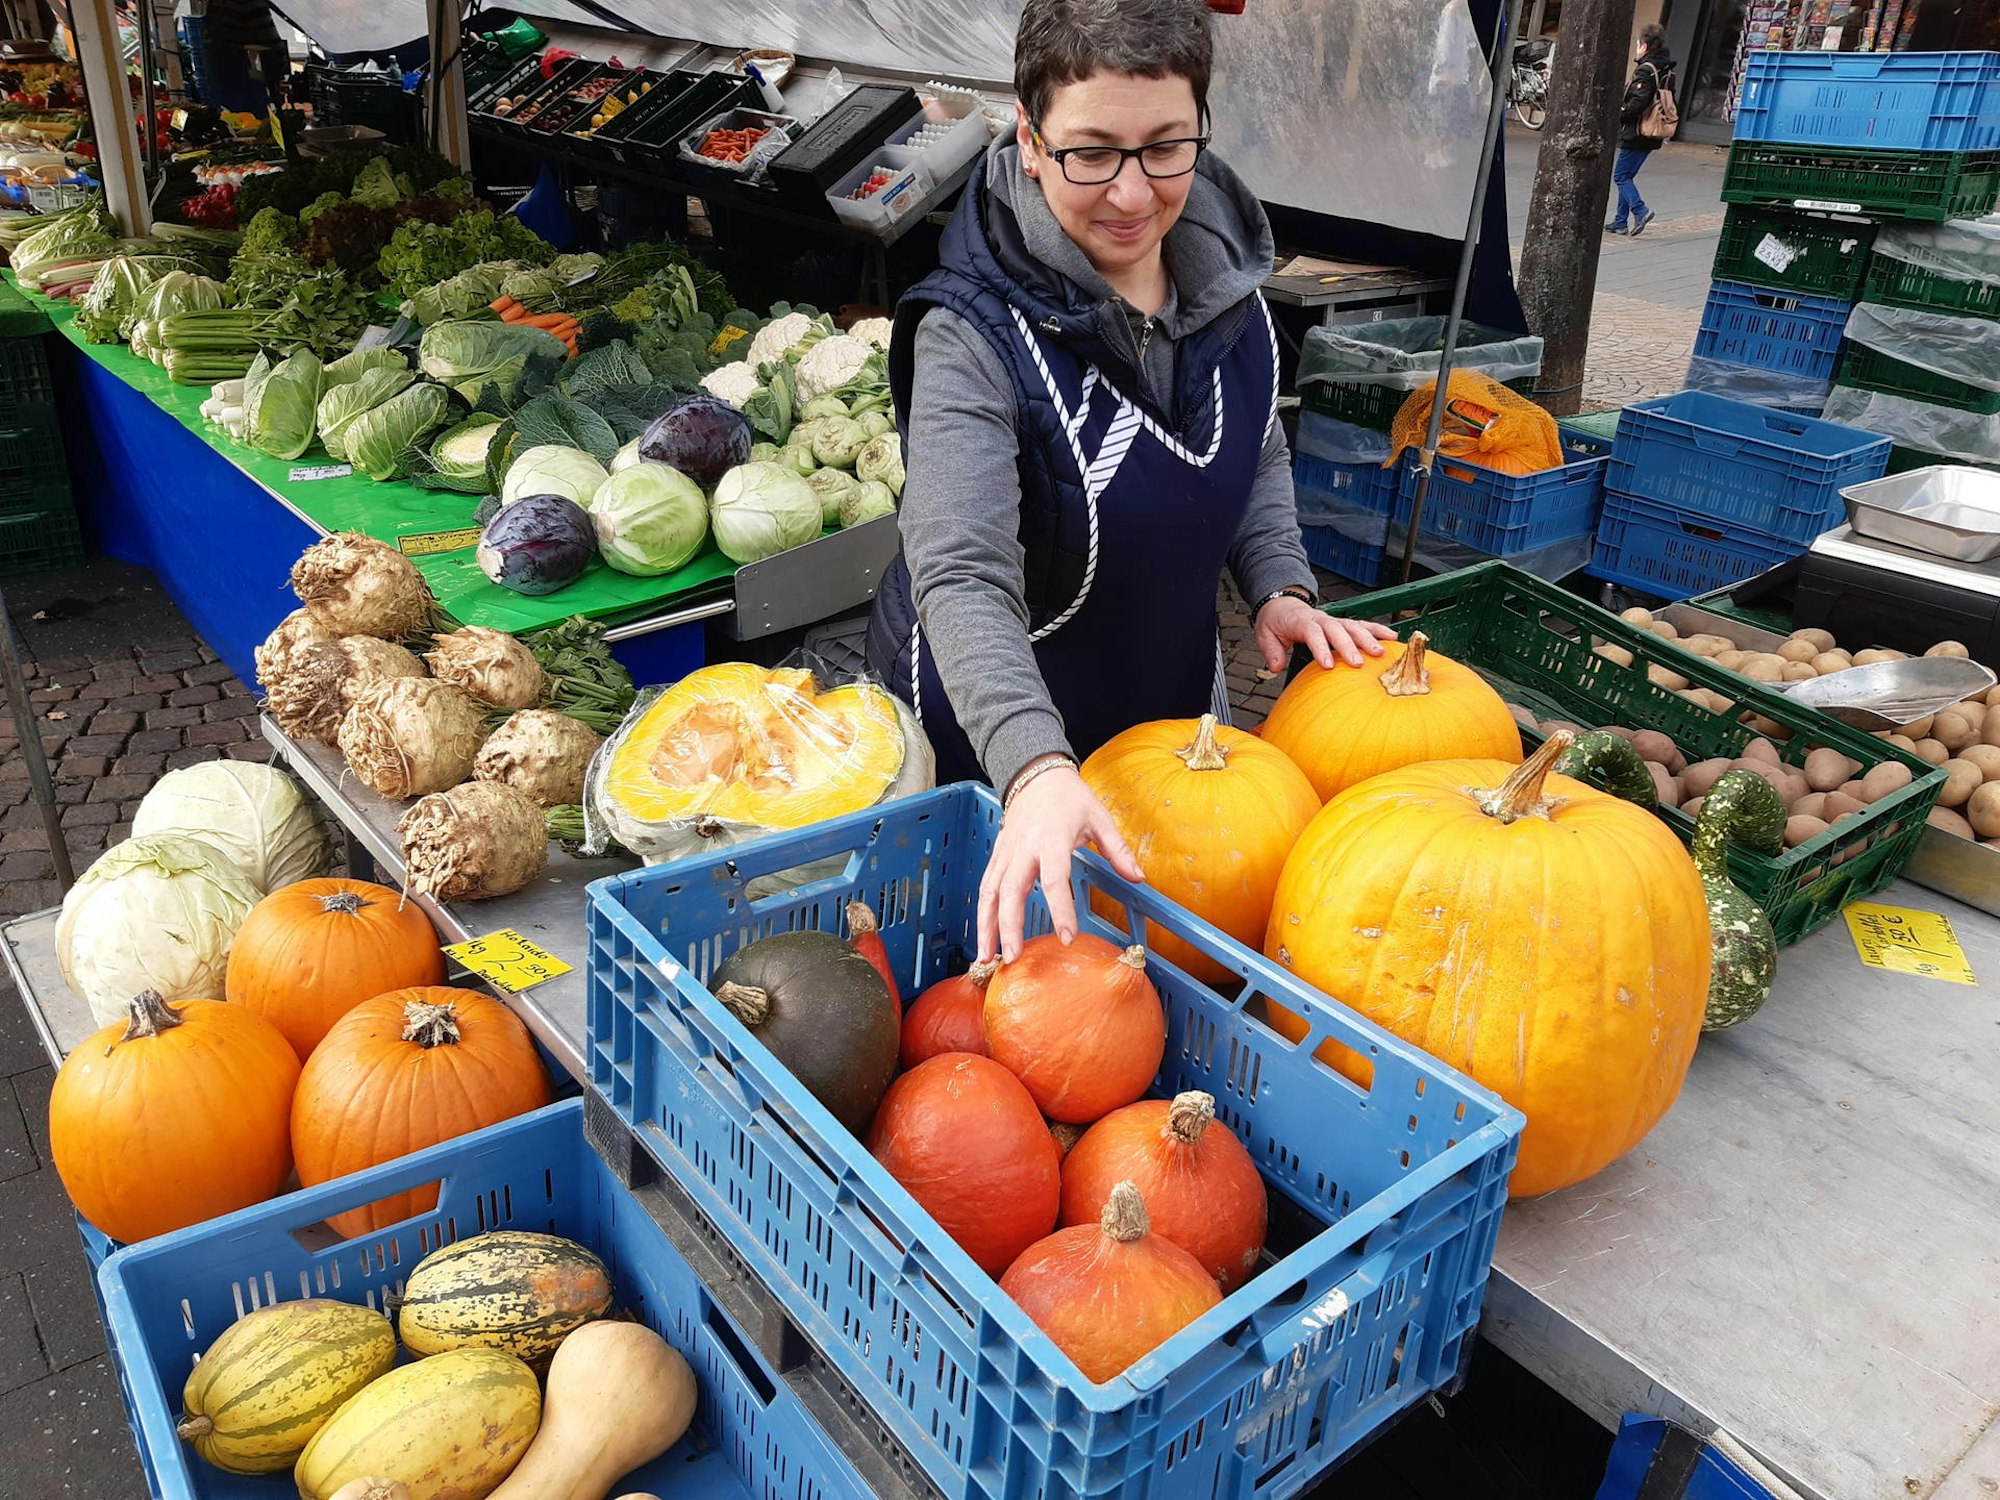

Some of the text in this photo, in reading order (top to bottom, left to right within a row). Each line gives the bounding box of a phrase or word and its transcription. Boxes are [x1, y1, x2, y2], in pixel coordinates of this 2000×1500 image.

[1889, 928, 1911, 943] 50
[483, 951, 525, 971] 2
[525, 963, 547, 975] 50
[1861, 938, 1885, 967] Laura
